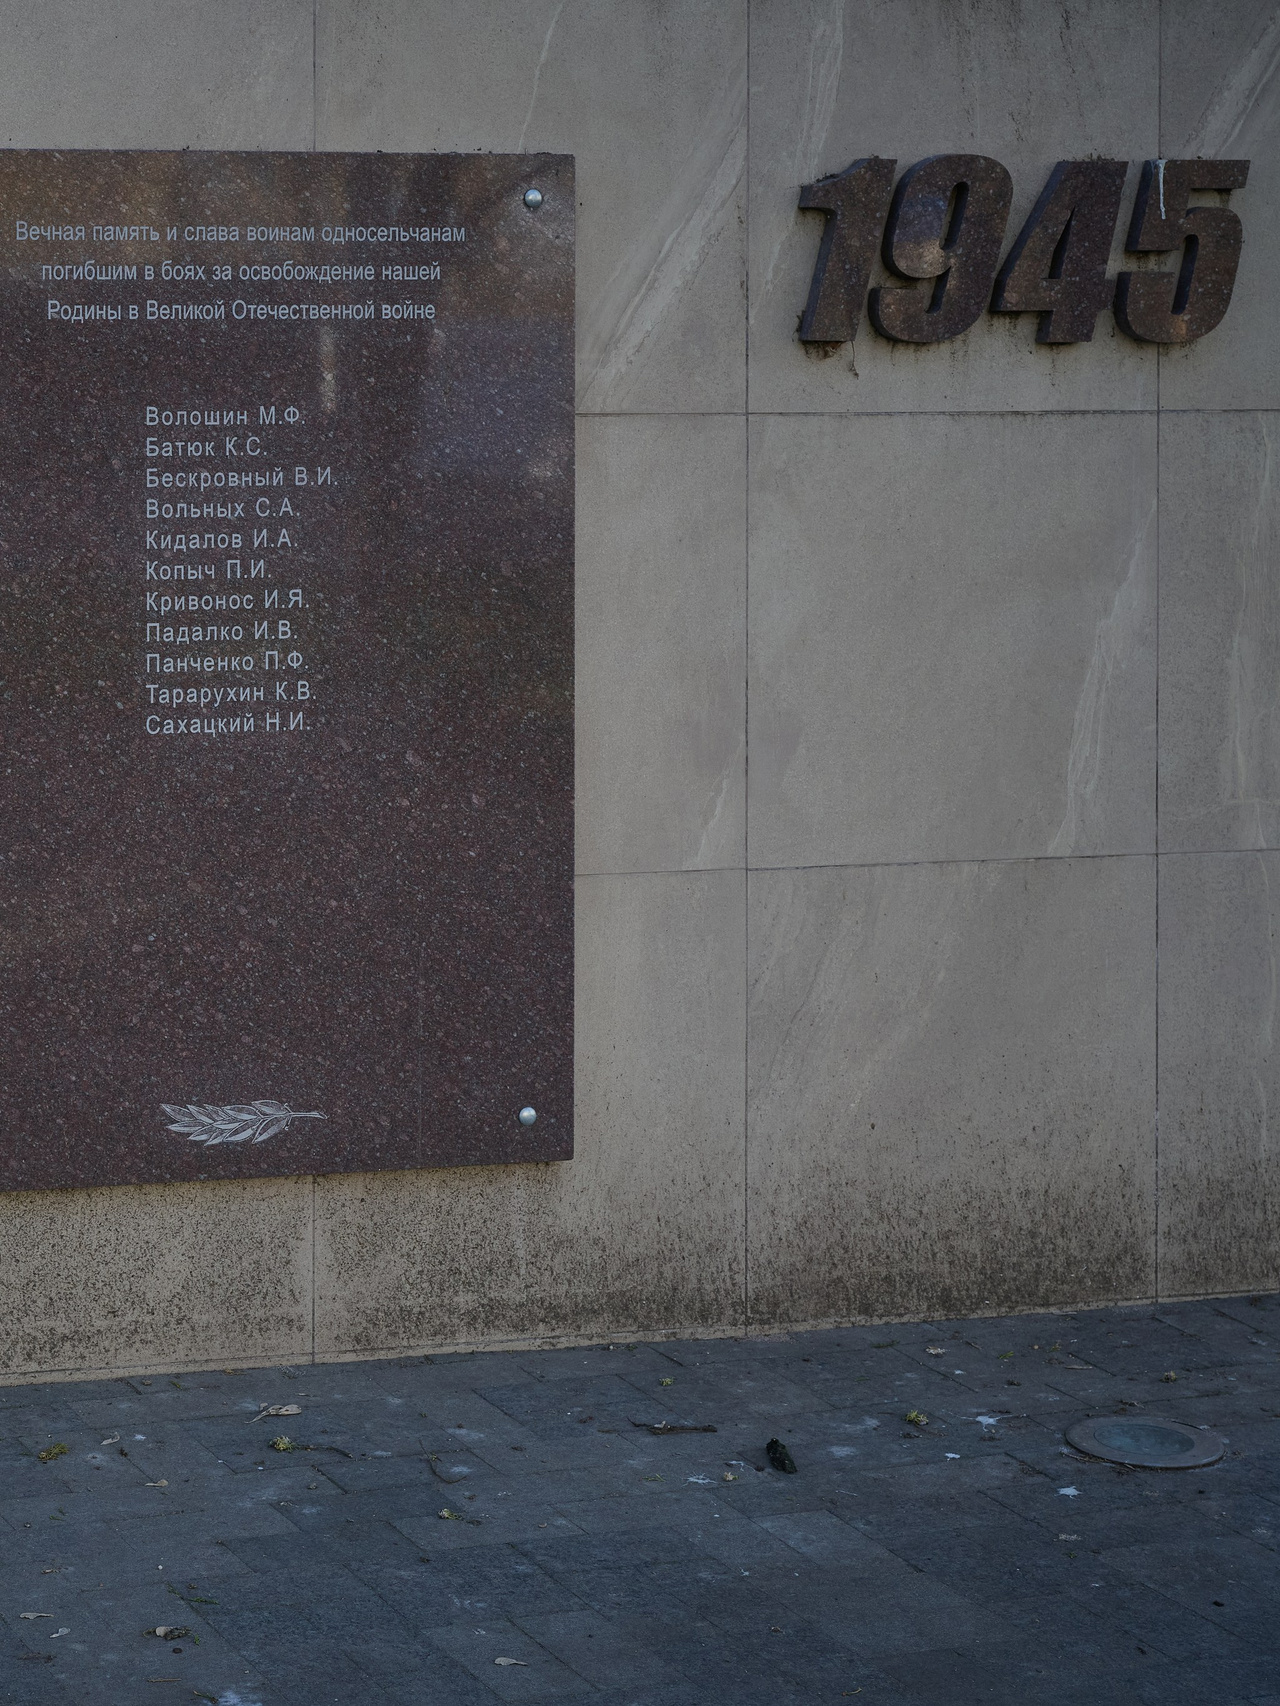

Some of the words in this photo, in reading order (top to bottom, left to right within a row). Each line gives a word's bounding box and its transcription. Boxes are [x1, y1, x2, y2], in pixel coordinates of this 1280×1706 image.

[15, 220, 86, 241] Вечная
[92, 225, 160, 243] память
[166, 226, 178, 242] и
[183, 225, 240, 242] слава
[246, 226, 315, 242] воинам
[321, 226, 466, 245] односельчанам
[798, 153, 1251, 343] 1945
[41, 259, 137, 281] погибшим
[144, 265, 155, 281] в
[161, 259, 206, 281] боях
[212, 265, 232, 281] за
[238, 260, 375, 284] освобождение
[381, 261, 441, 281] нашей
[47, 299, 122, 324] Родины
[128, 304, 139, 320] в
[146, 299, 225, 321] Великой
[231, 299, 375, 320] Отечественной
[381, 300, 436, 320] войне
[144, 405, 248, 426] Волошин
[259, 405, 305, 425] М.Ф.
[145, 436, 215, 457] Батюк
[225, 436, 268, 457] К.С.
[146, 467, 284, 492] Бескровный
[294, 466, 338, 486] В.И.
[146, 498, 245, 520] Вольных
[255, 497, 301, 518] С.А.
[145, 530, 243, 553] Кидалов
[253, 528, 298, 549] И.А.
[145, 560, 215, 581] Копыч
[226, 559, 272, 579] П.И.
[146, 591, 254, 616] Кривонос
[264, 588, 310, 609] И.Я.
[146, 622, 244, 645] Падалко
[254, 619, 298, 640] И.В.
[145, 653, 254, 673] Панченко
[264, 650, 309, 670] П.Ф.
[145, 683, 264, 708] Тарарухин
[275, 680, 317, 701] К.В.
[145, 712, 255, 738] Сахацкий
[265, 711, 311, 732] Н.И.
